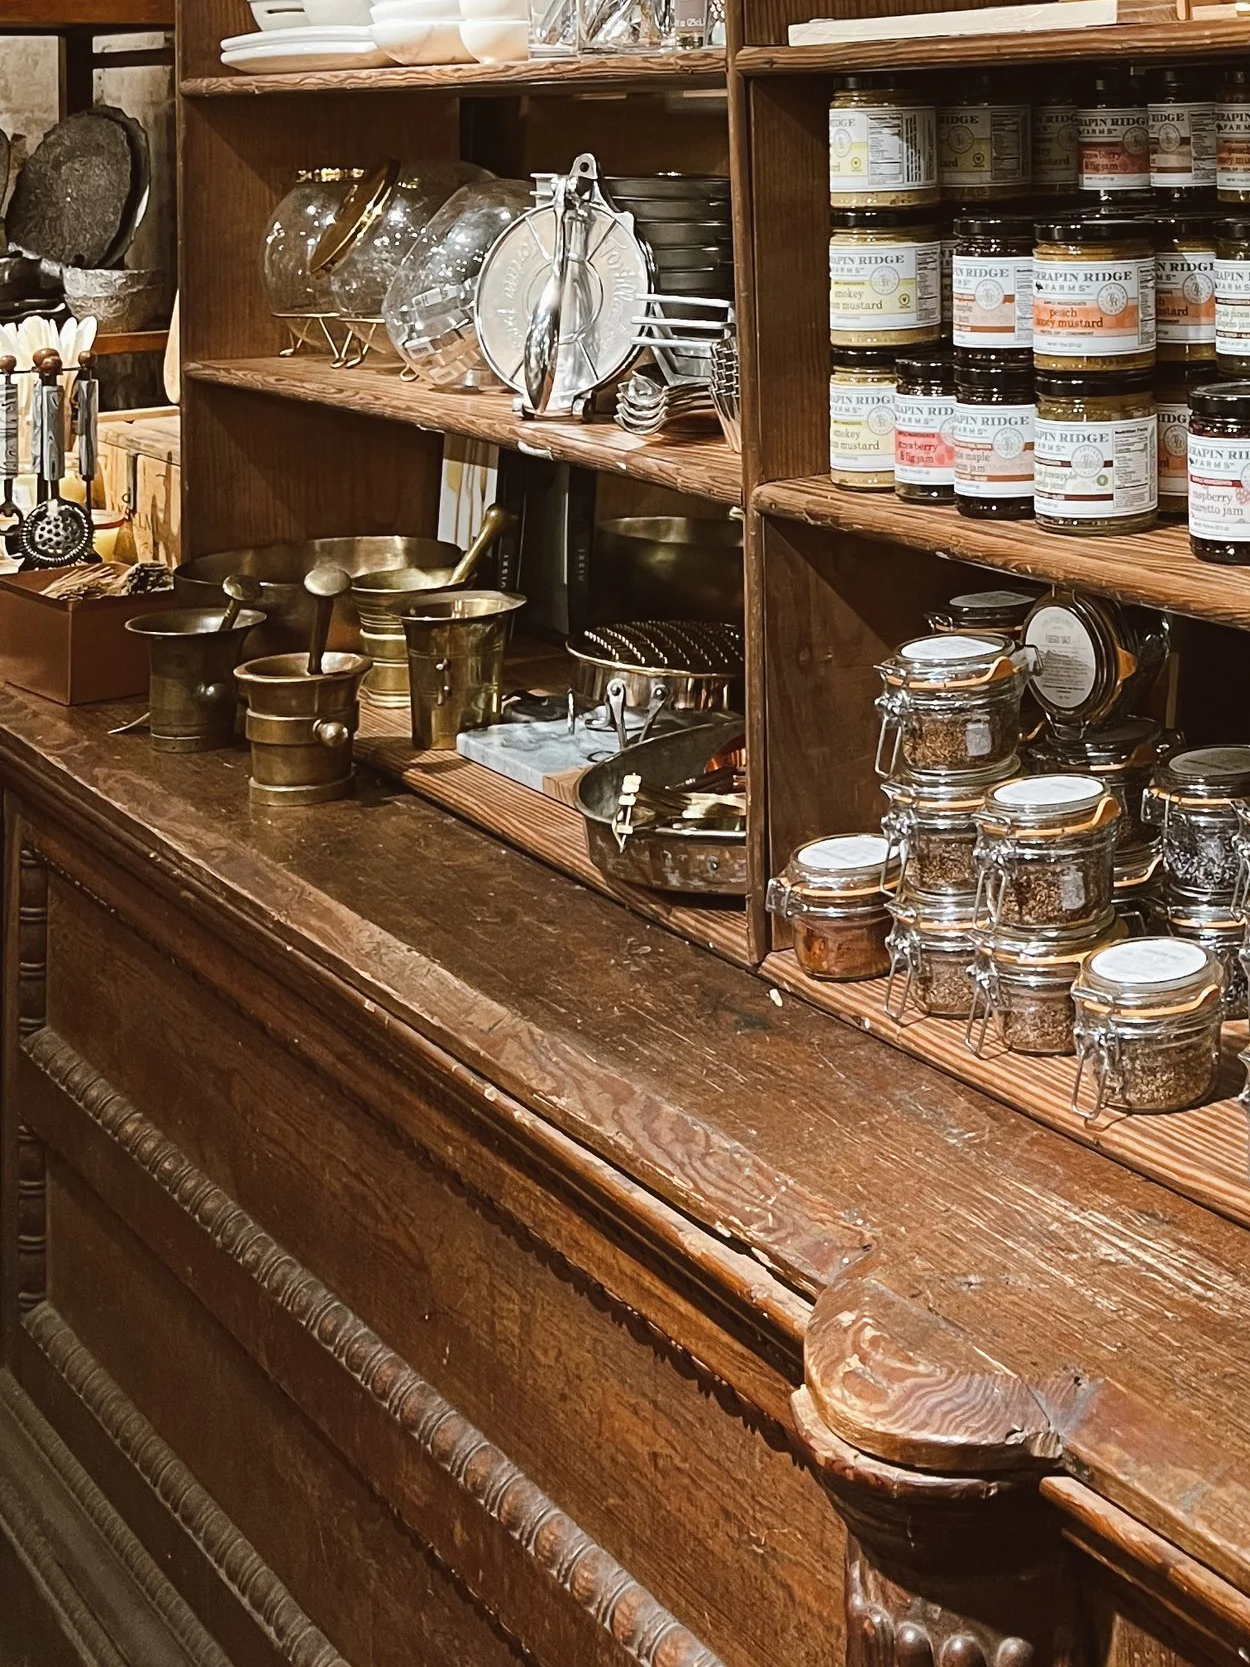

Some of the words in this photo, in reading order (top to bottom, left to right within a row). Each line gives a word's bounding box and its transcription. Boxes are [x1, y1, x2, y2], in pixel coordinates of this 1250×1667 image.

[857, 254, 905, 265] RIDGE
[966, 268, 1010, 278] RIDGE
[1082, 270, 1133, 282] RIDGE
[1049, 307, 1078, 319] peach
[1058, 317, 1104, 329] mustard
[980, 416, 1030, 427] RIDGE
[1060, 433, 1110, 444] RIDGE
[841, 440, 881, 451] mustard
[967, 453, 991, 465] maple
[968, 463, 986, 475] jam
[1222, 506, 1245, 518] jam
